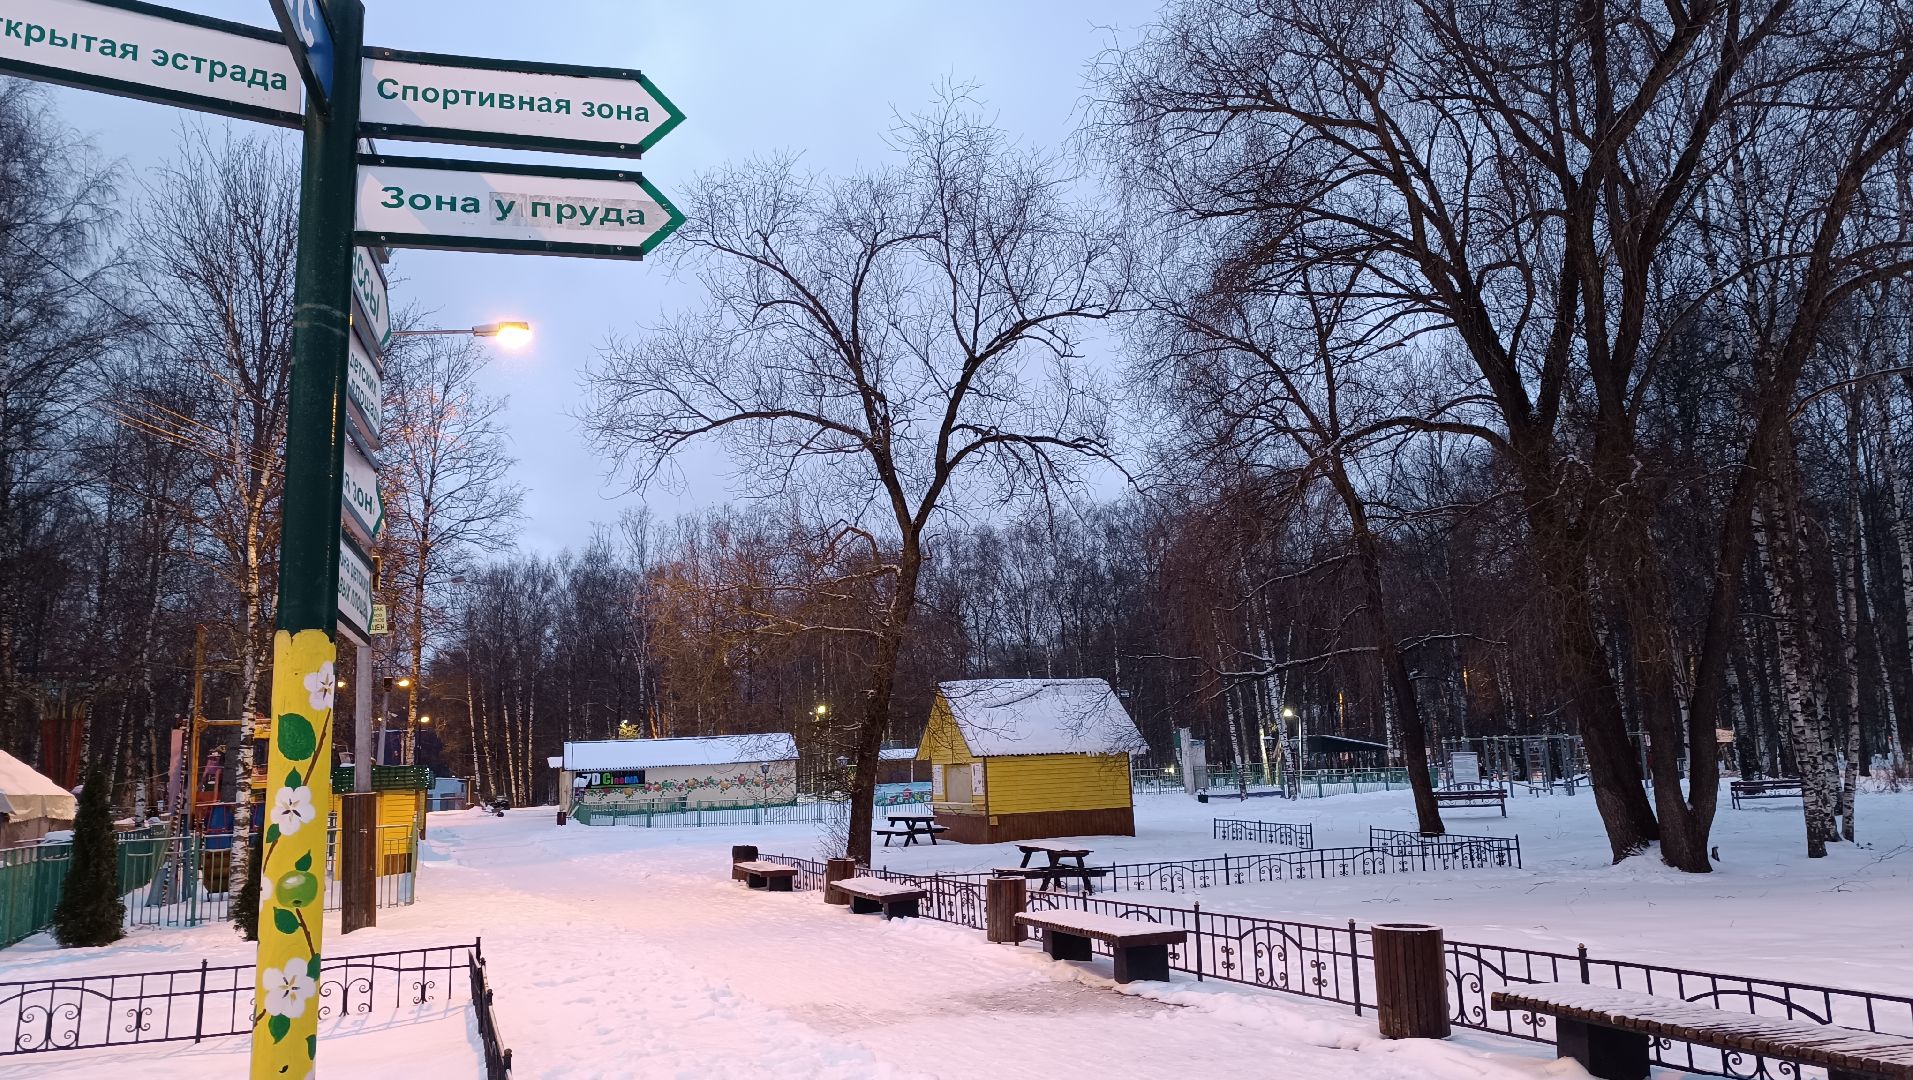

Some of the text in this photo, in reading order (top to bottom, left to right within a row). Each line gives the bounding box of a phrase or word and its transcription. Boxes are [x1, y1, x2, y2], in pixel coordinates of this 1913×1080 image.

[0, 17, 287, 92] крытая эстрада
[376, 79, 650, 122] Спортивная зона
[381, 185, 645, 226] Зона у пруда
[352, 481, 376, 515] зон
[581, 772, 601, 787] 7D
